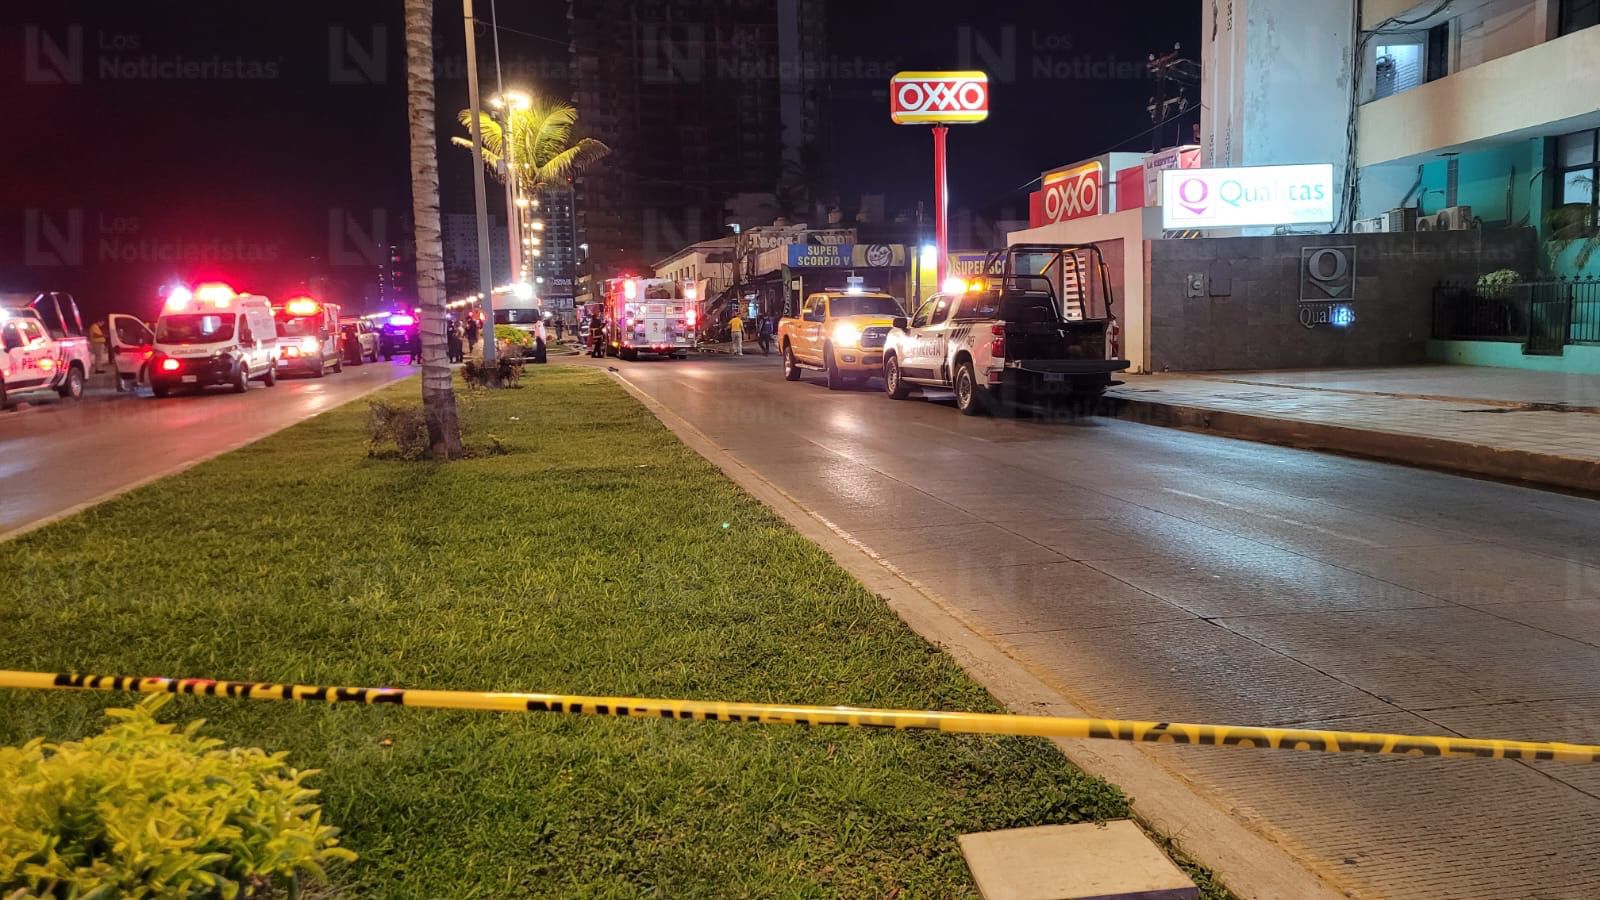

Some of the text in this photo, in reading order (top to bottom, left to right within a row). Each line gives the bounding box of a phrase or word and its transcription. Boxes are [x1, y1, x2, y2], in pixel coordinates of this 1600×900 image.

[898, 81, 985, 112] OXXO
[1045, 172, 1097, 226] OXXO
[797, 256, 850, 266] SCORPIO V
[807, 245, 838, 256] SUPER
